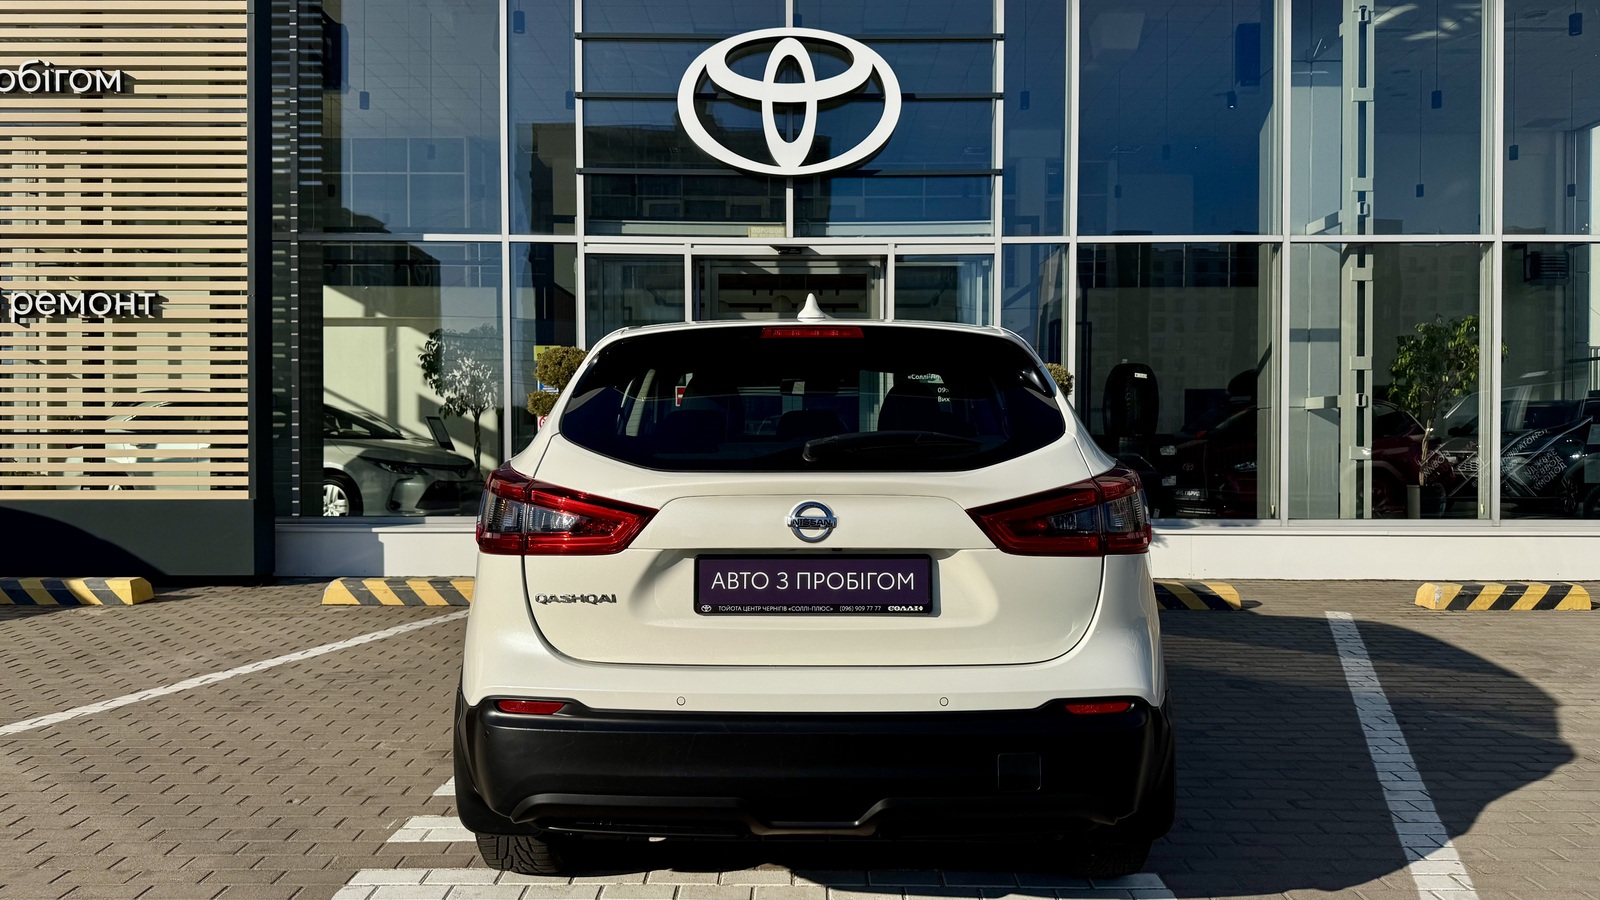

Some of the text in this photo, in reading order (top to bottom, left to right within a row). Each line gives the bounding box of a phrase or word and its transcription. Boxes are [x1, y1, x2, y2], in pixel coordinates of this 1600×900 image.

[10, 291, 156, 323] ремонт
[792, 518, 831, 526] NISSAN
[711, 571, 769, 590] АВТО
[797, 571, 914, 590] ПРОБІГОМ
[534, 593, 617, 605] QASHQAI
[718, 604, 742, 612] ТОЙОТА
